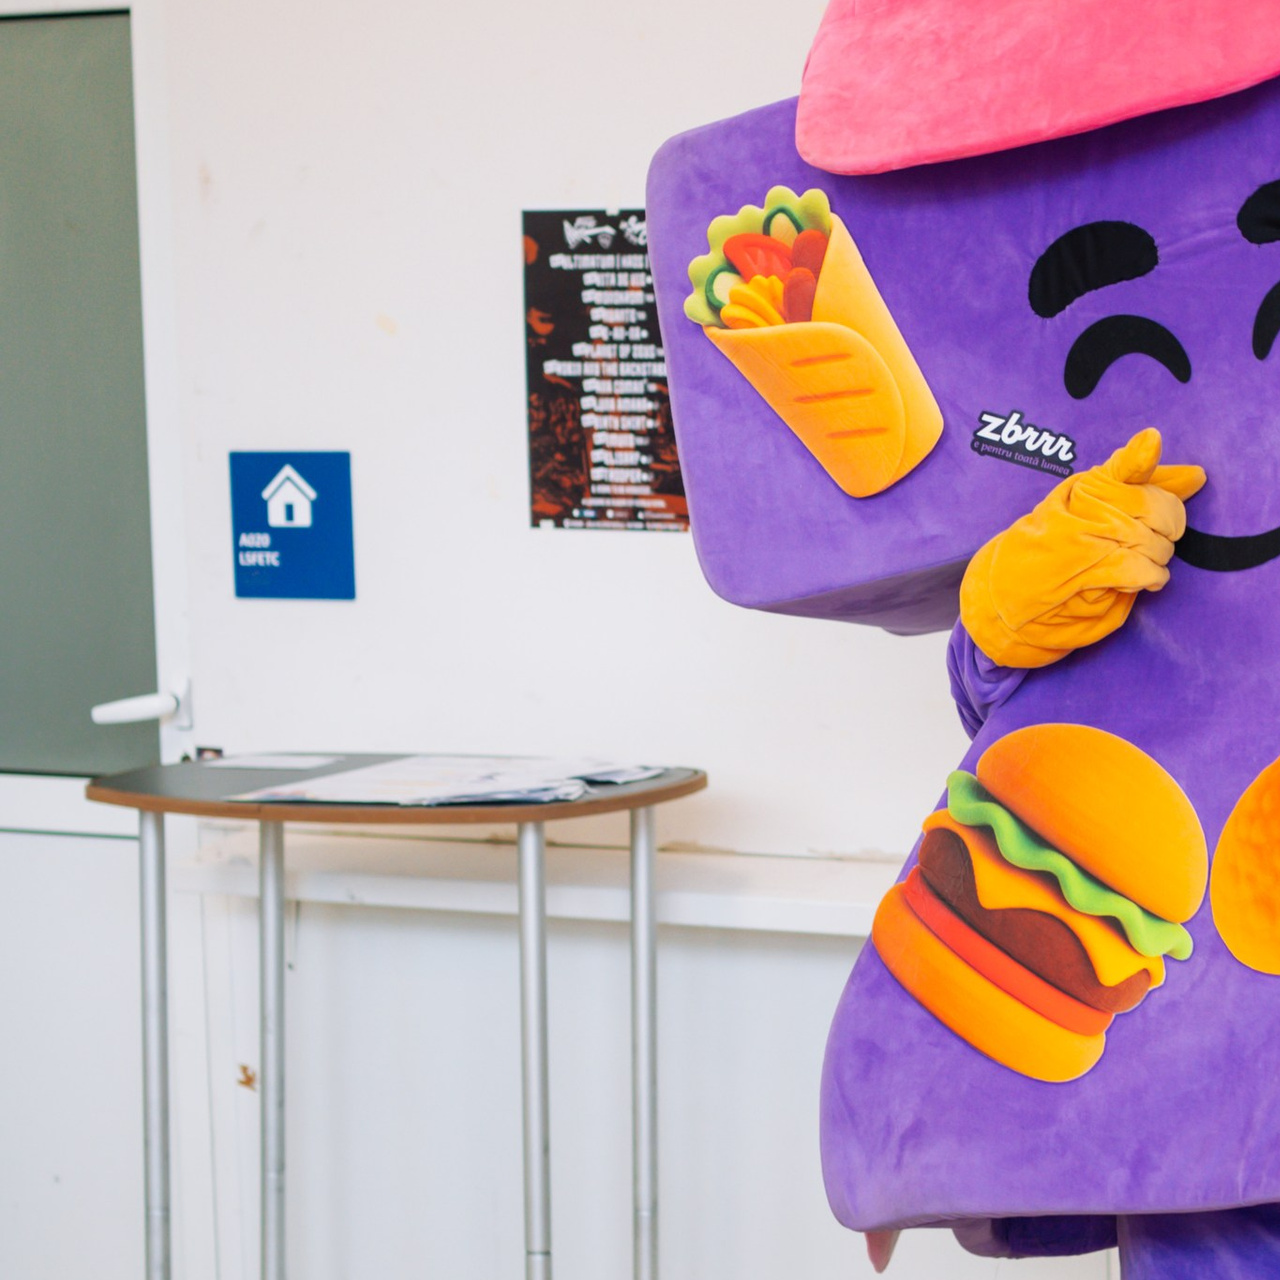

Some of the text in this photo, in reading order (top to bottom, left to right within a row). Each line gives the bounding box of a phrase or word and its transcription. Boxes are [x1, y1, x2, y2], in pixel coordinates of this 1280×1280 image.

[976, 412, 1074, 461] zbrrr
[981, 442, 1012, 458] pentru
[1014, 452, 1039, 466] toată
[1041, 458, 1070, 476] lumea
